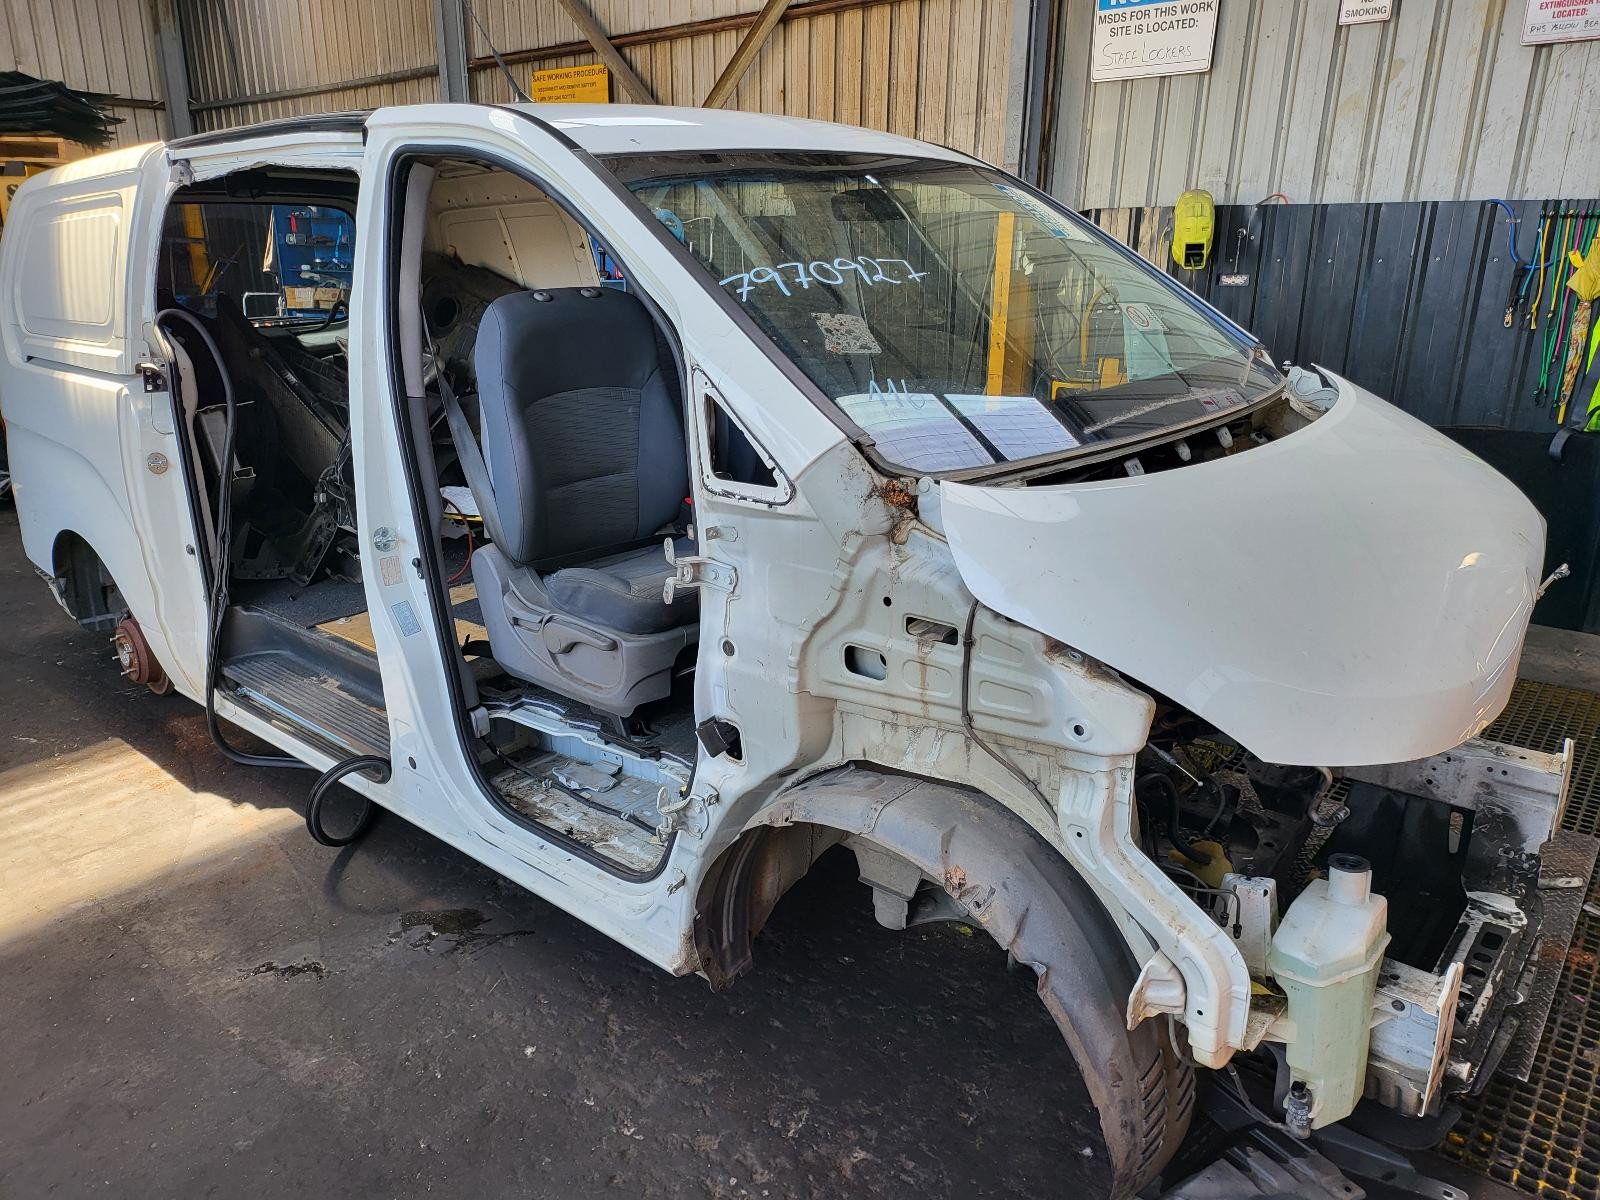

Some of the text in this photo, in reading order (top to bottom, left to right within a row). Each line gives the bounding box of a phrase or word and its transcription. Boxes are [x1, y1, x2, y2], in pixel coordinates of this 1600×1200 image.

[1098, 1, 1214, 25] MSDS FOR THIS WORK
[1344, 5, 1388, 18] SMOKING
[1552, 8, 1589, 19] LOCATED:
[1109, 18, 1199, 38] SITE IS LOCATED:
[1101, 41, 1192, 66] STAFF LOCKERS
[533, 67, 607, 82] SAFE WORKING PROCEDURE
[718, 256, 932, 302] 7970927
